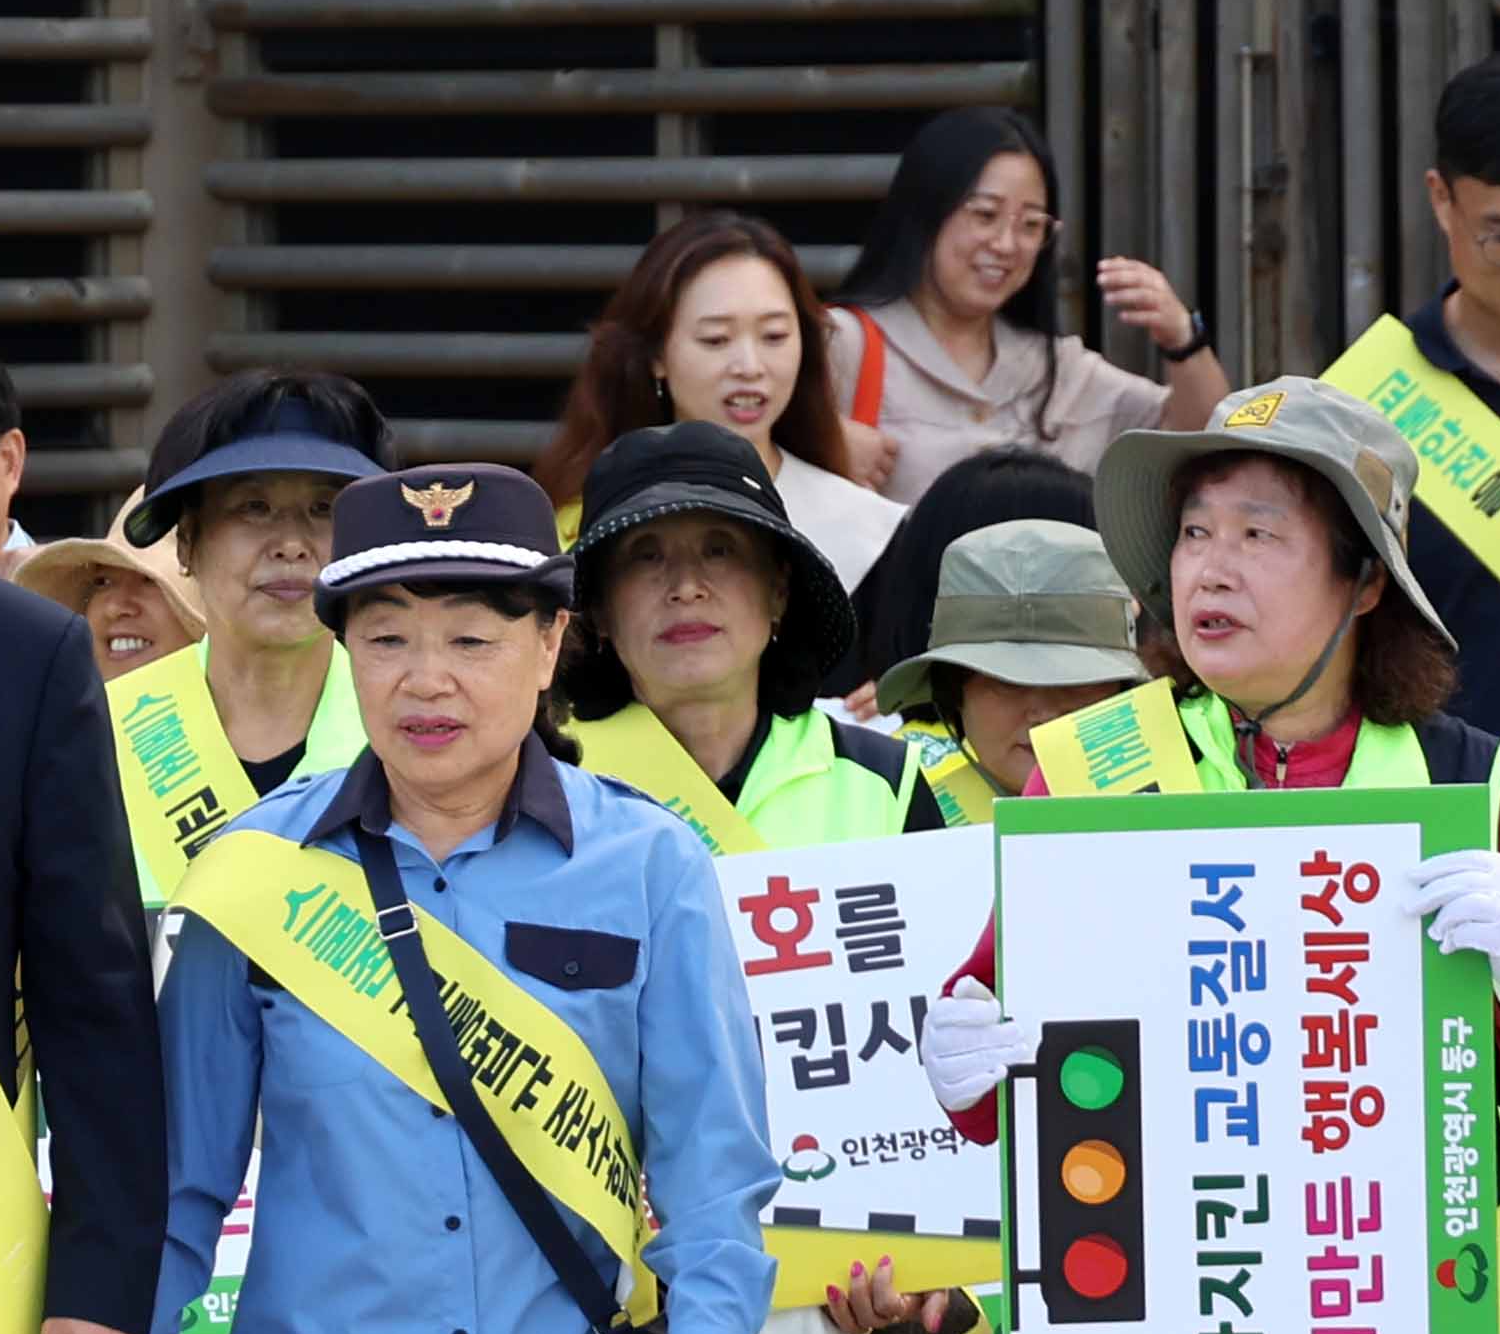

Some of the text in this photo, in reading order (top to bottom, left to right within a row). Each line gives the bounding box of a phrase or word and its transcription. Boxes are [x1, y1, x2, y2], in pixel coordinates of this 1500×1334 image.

[121, 693, 202, 798] 스쿨존
[738, 875, 907, 977] 호를
[1188, 863, 1271, 1146] 교통질서
[1300, 850, 1386, 1154] 행복세상
[752, 995, 932, 1092] 킵시
[1441, 1016, 1480, 1238] 인천광역시 동구
